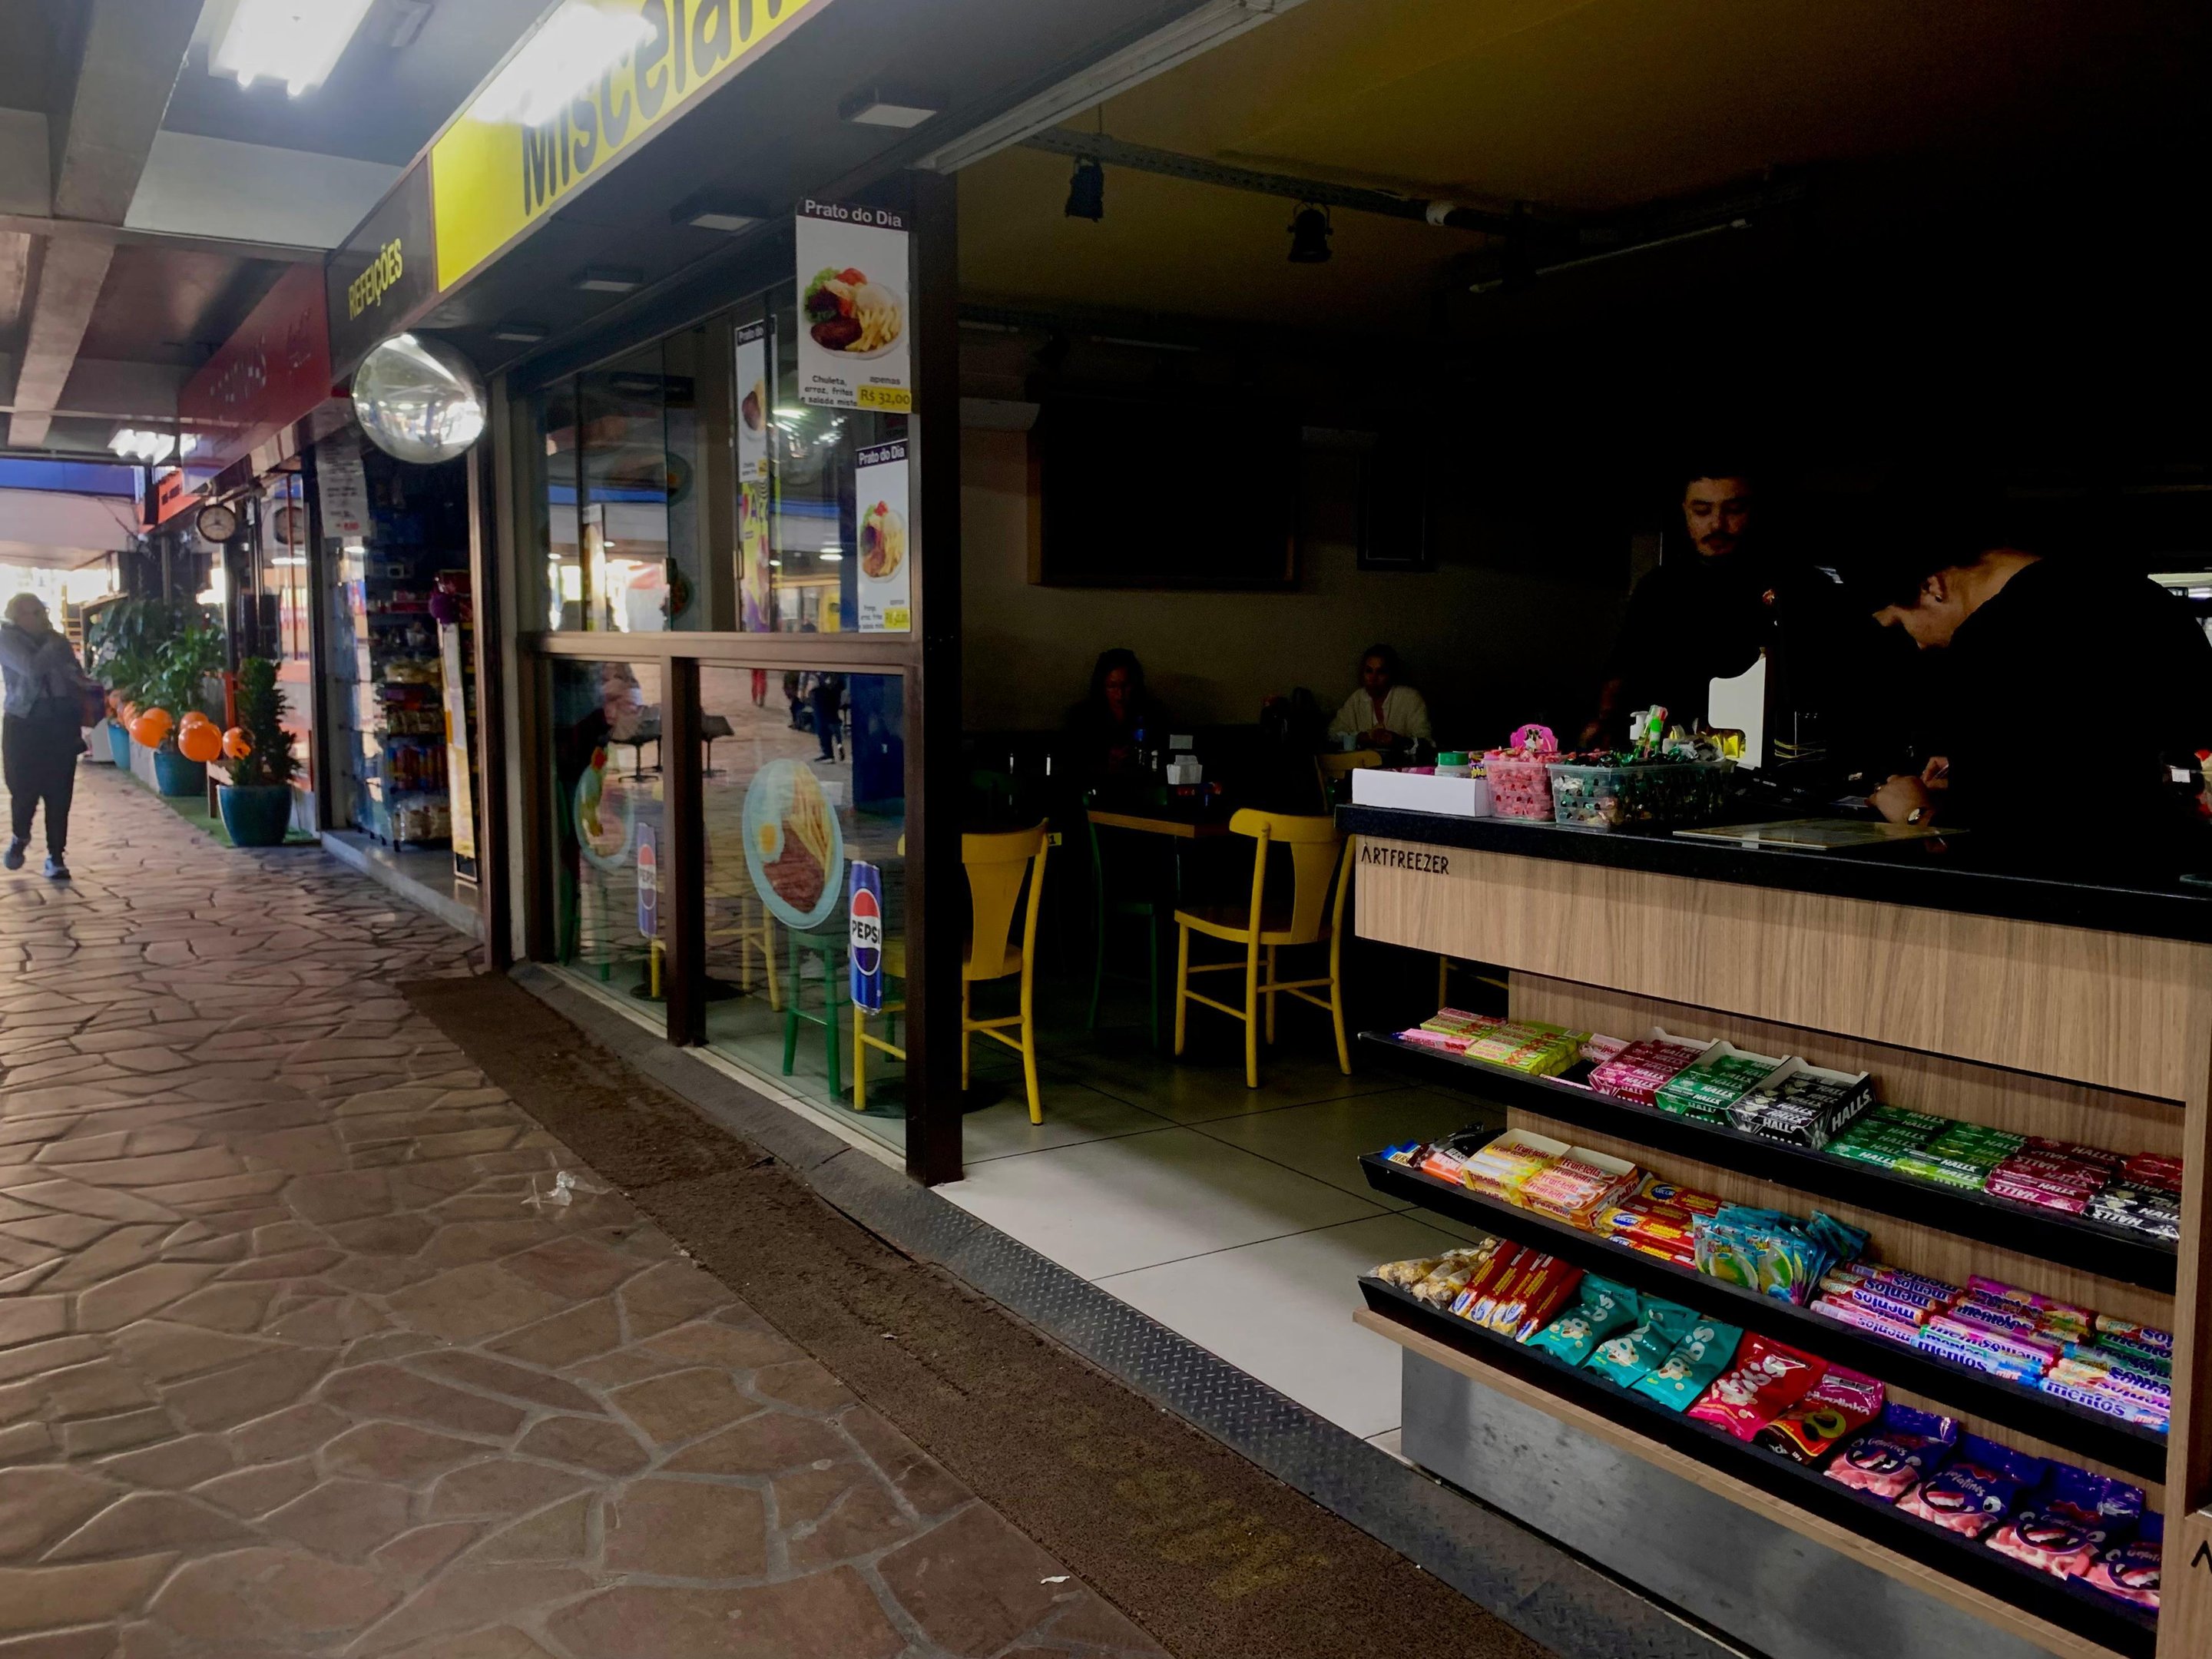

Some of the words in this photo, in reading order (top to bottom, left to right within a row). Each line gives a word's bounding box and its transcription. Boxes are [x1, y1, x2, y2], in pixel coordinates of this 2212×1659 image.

[805, 199, 848, 219] Prato
[852, 207, 873, 222] do
[876, 210, 902, 227] Dia
[348, 237, 402, 320] REFEIÇÕES
[812, 375, 847, 386] Chuleta,
[869, 376, 901, 386] apenas
[804, 386, 828, 395] arroz,
[832, 386, 853, 396] fritas
[860, 389, 875, 402] R$
[878, 393, 910, 406] 32,00
[859, 452, 879, 465] Prato
[879, 448, 891, 462] do
[891, 445, 905, 459] Dia
[1361, 845, 1449, 875] ARTFREEZER
[852, 919, 881, 945] PEPSI
[1621, 1076, 1657, 1088] HALLS
[1631, 1068, 1666, 1081] HALLS
[1691, 1094, 1723, 1106] HALLS
[1699, 1085, 1736, 1099] HALLS
[1832, 1088, 1870, 1132] HALLS
[1907, 1112, 1945, 1124] HALLS
[1902, 1119, 1936, 1131] HALLS
[1878, 1135, 1919, 1149] HALLS
[1887, 1128, 1929, 1141] HALLS
[1515, 1144, 1549, 1159] Fruit-tella
[1869, 1144, 1901, 1154] HALL
[2071, 1146, 2119, 1161] HALLS
[1561, 1158, 1601, 1178] Fruit-tella
[1940, 1159, 1981, 1173] HALLS
[2015, 1155, 2061, 1171] HALLS
[1552, 1166, 1591, 1184] Fruit-tella
[1936, 1168, 1980, 1183] HALLS
[1528, 1182, 1566, 1201] Fruit-tella
[1541, 1174, 1580, 1193] Fruit-tella
[2038, 1183, 2078, 1196] HALLS
[1992, 1184, 2039, 1200] HALLS
[2093, 1209, 2144, 1226] HALLS
[1864, 1278, 1931, 1309] mentos
[1892, 1277, 1949, 1303] mentos
[1853, 1289, 1916, 1320] mentos
[1857, 1316, 1912, 1343] mentos
[2104, 1333, 2172, 1359] mento
[1918, 1340, 1988, 1373] mentos
[2046, 1382, 2125, 1416] mentos
